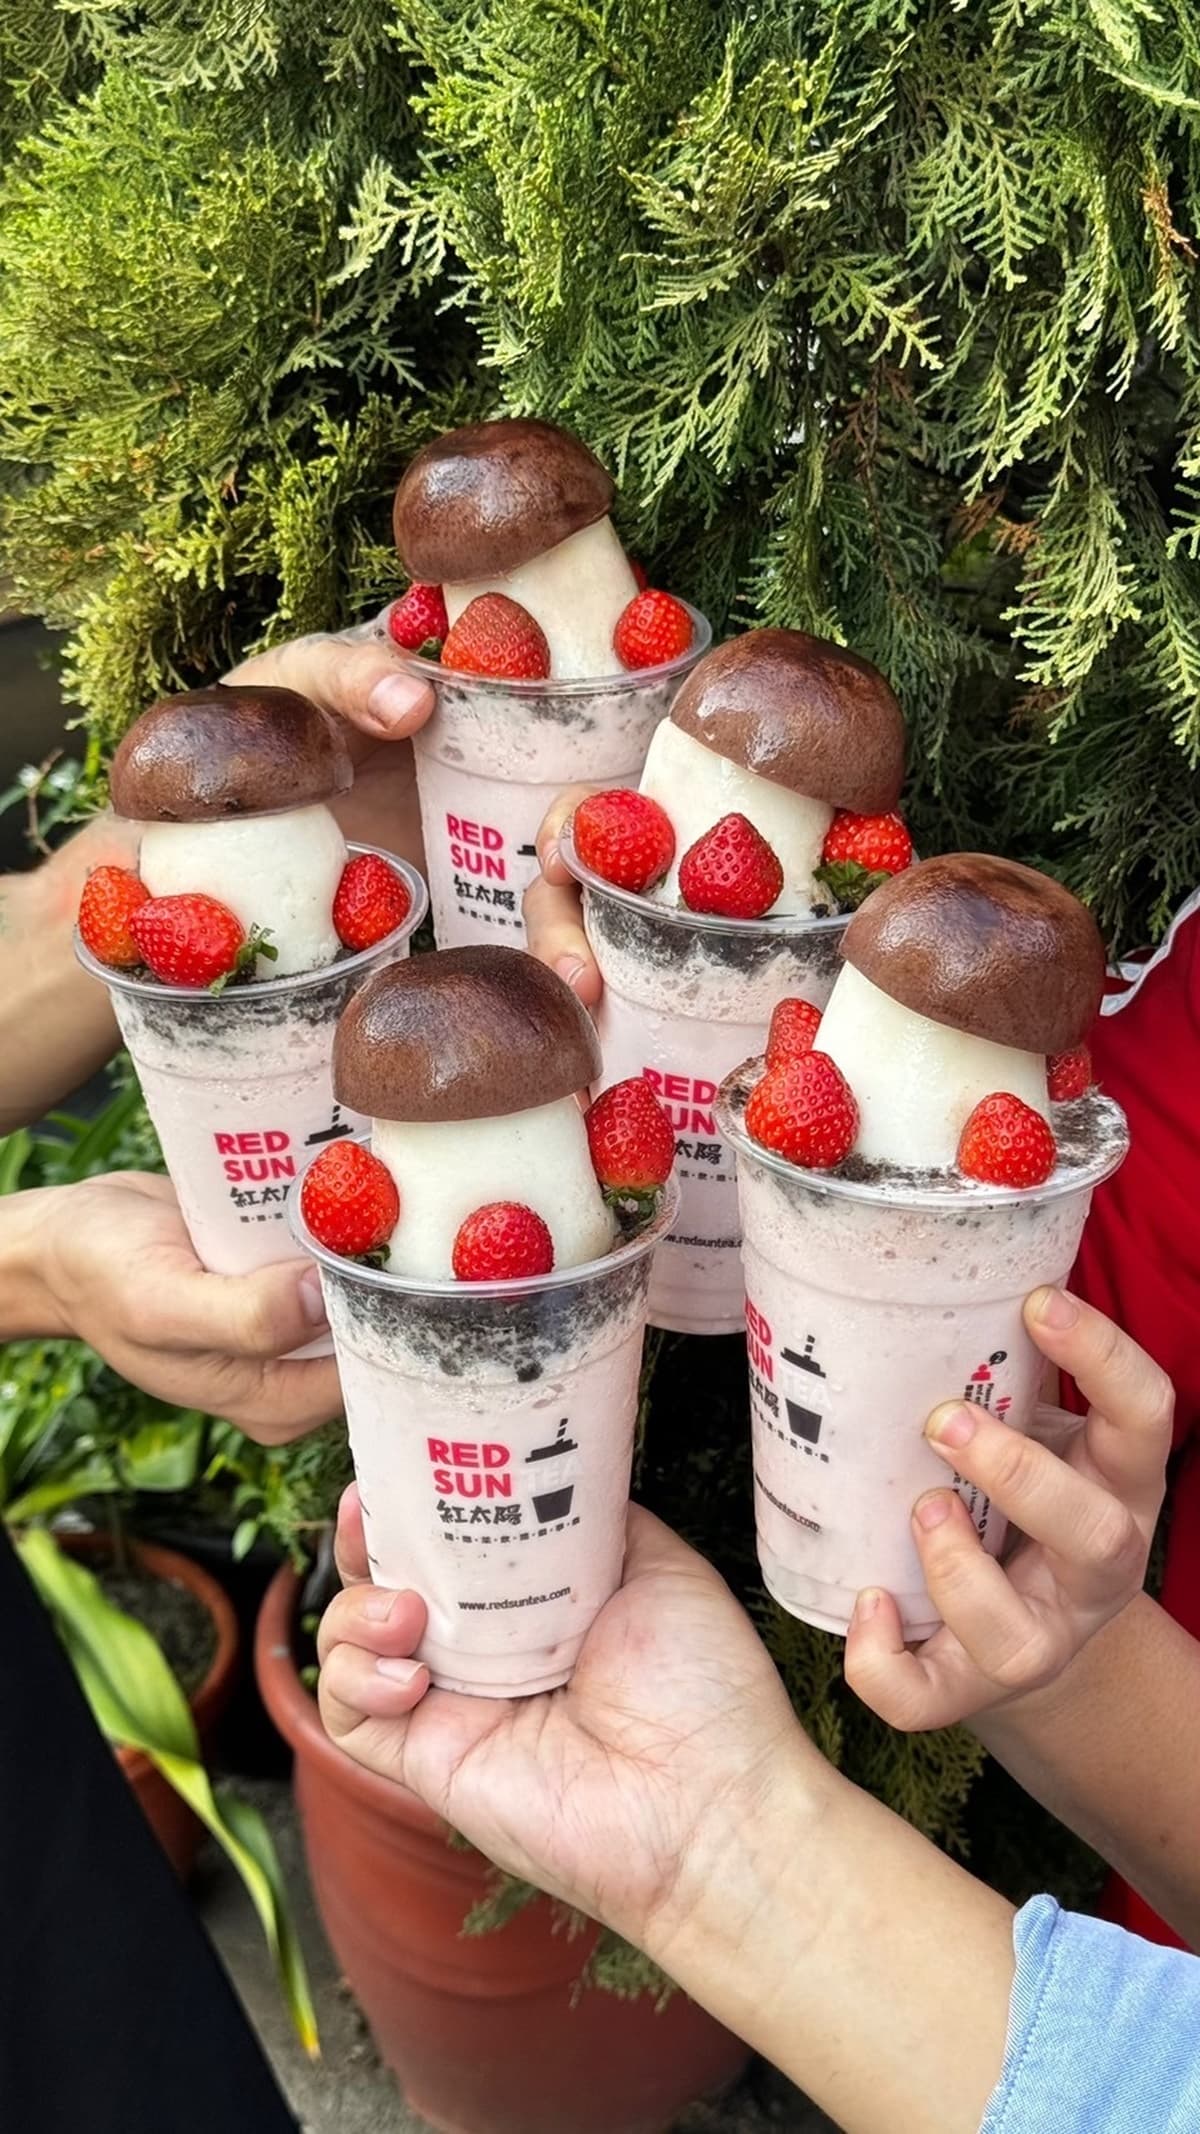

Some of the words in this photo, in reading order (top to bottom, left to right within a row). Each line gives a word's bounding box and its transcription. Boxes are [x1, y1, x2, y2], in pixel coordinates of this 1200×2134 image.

[446, 813, 504, 851] RED
[451, 844, 506, 881] SUN
[643, 1067, 717, 1105] RED
[664, 1104, 715, 1136] UN
[214, 1130, 290, 1155] RED
[675, 1139, 722, 1166] 太陽
[223, 1156, 296, 1182] SUN
[230, 1185, 290, 1208] 紅太
[427, 1437, 510, 1469] RED
[433, 1469, 512, 1498] SUN
[436, 1499, 522, 1525] 紅太陽
[458, 1586, 571, 1611] www.redsuntea.com
